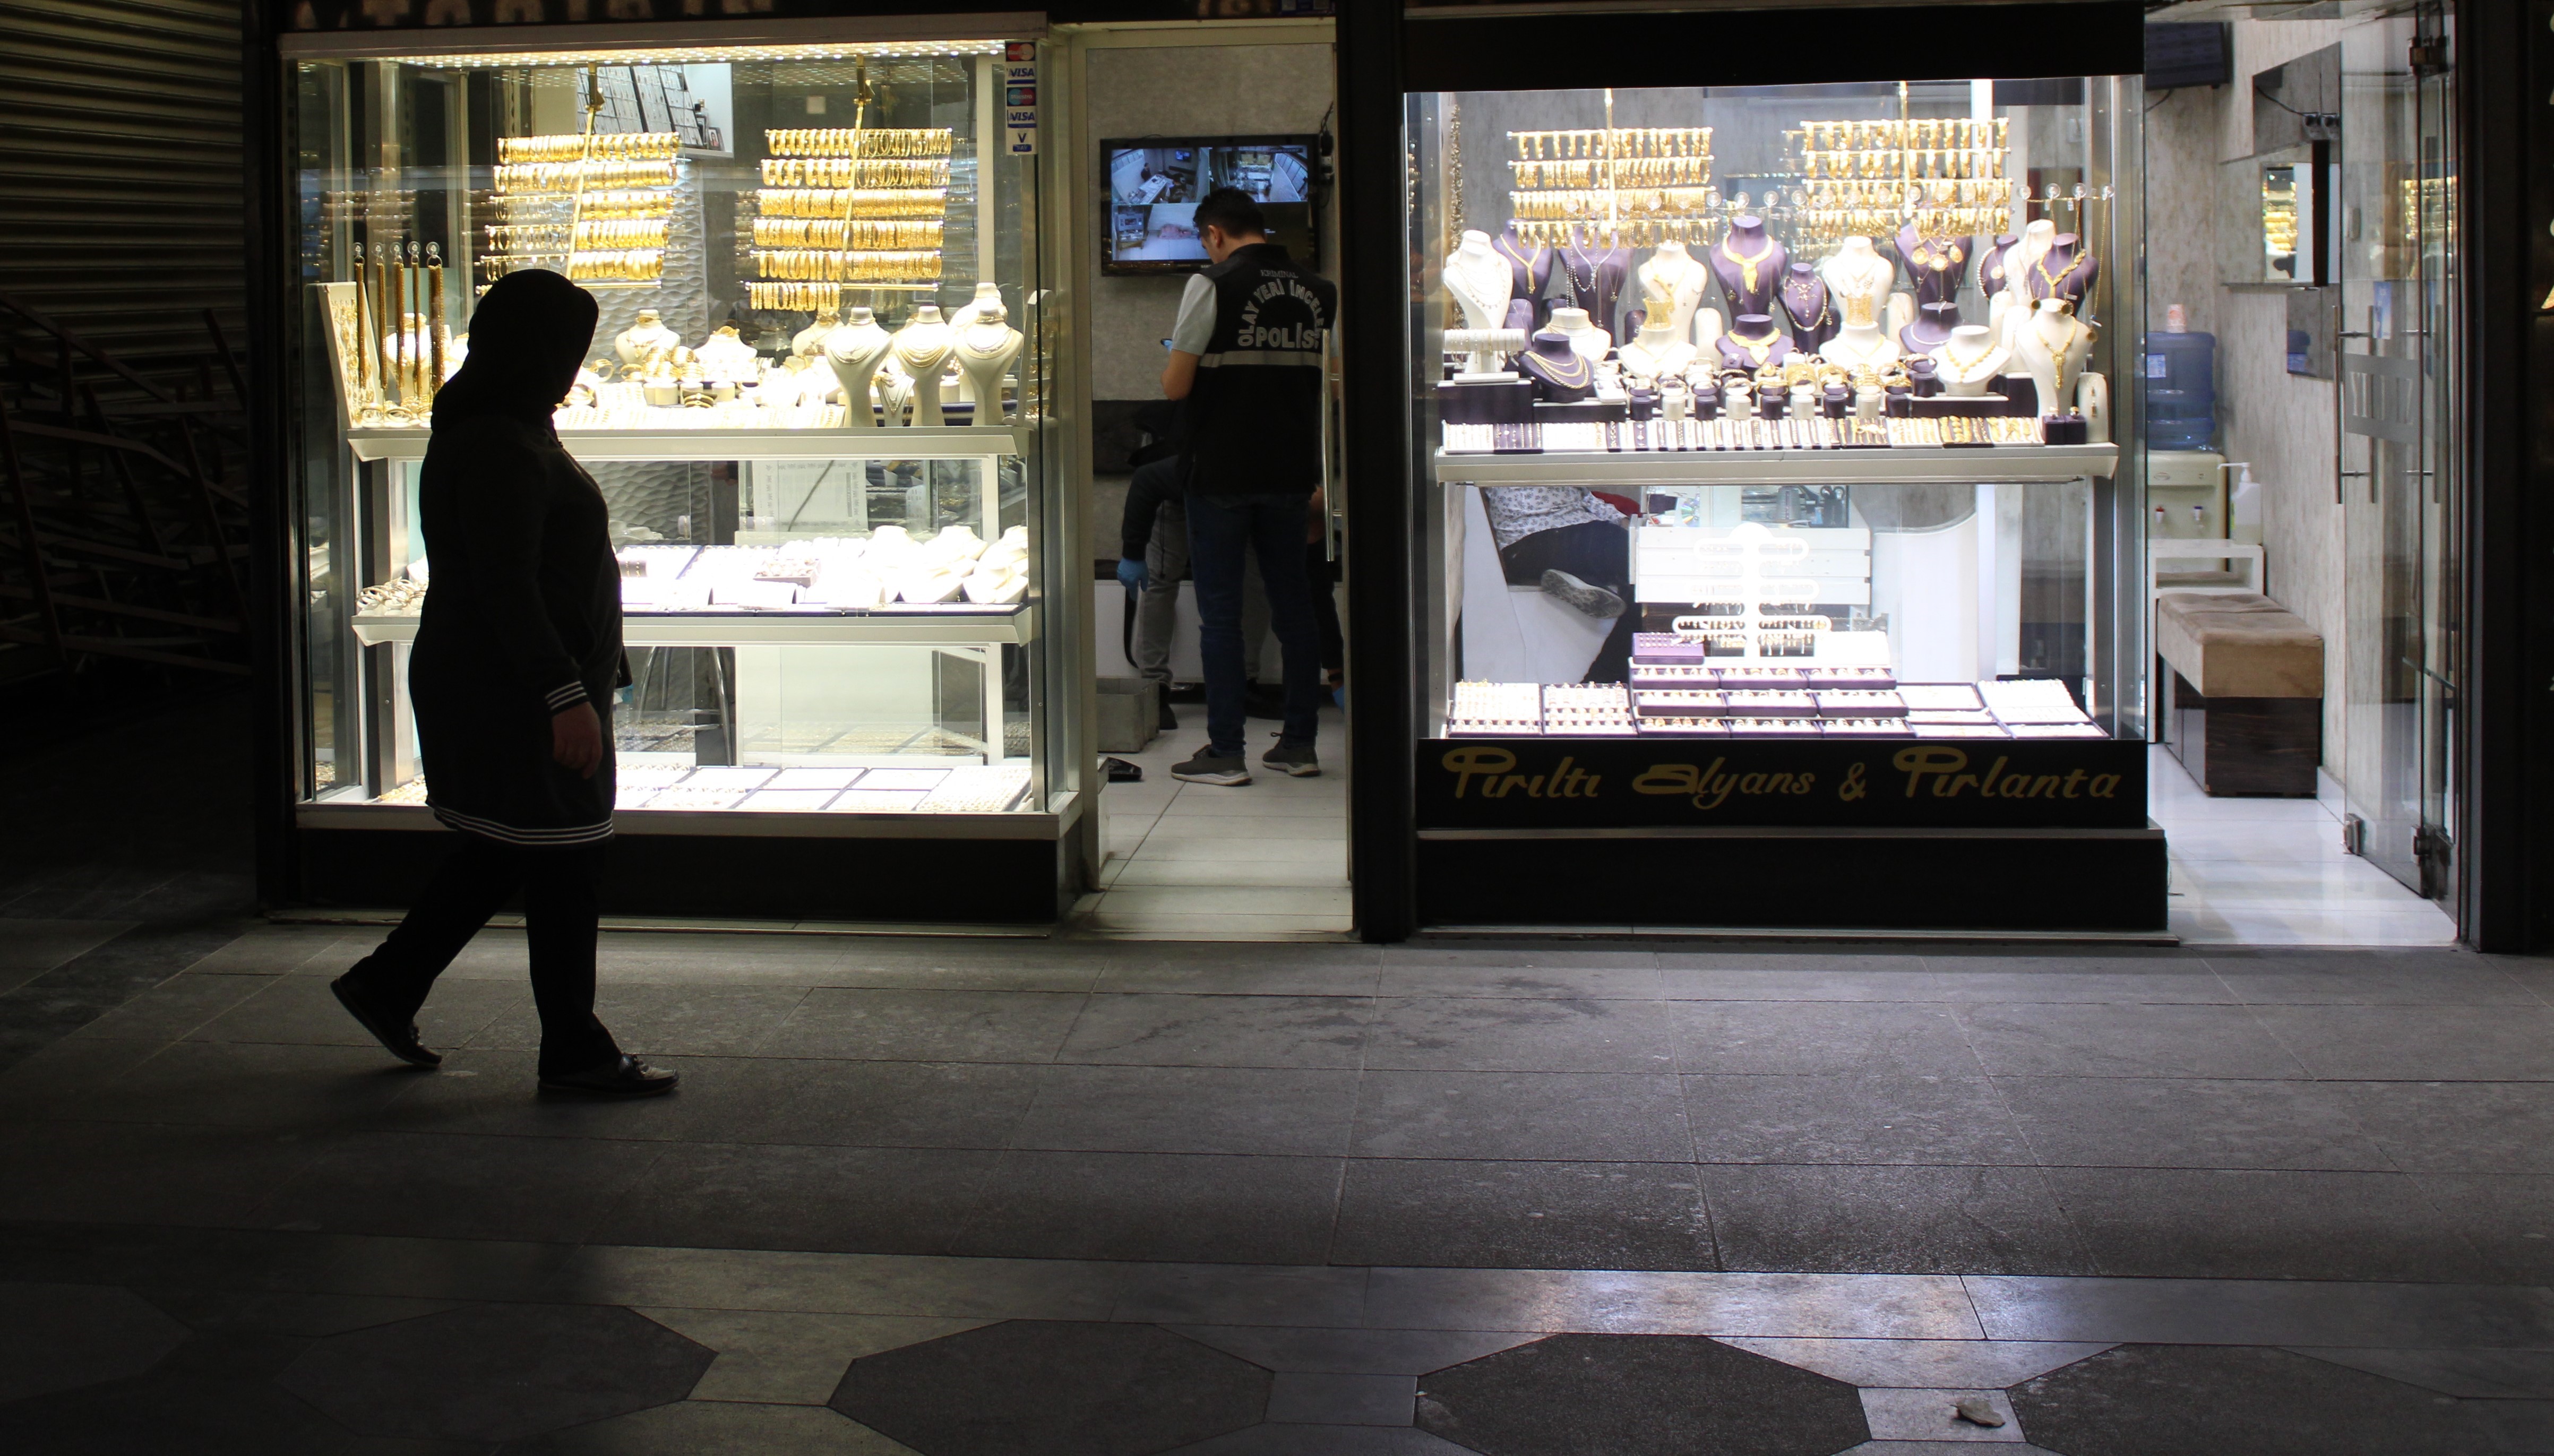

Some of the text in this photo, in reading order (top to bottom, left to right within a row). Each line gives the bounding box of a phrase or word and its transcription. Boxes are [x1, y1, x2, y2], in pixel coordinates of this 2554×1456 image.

[1009, 67, 1035, 77] VISA
[1009, 111, 1035, 121] VISA
[1017, 132, 1027, 143] V
[1237, 300, 1260, 347] OLAY
[1253, 278, 1285, 304] YERİ
[1255, 322, 1315, 349] POLİS
[1631, 756, 1816, 810] Alyans
[1838, 761, 1867, 802] &
[1892, 745, 2122, 799] Pırlanta
